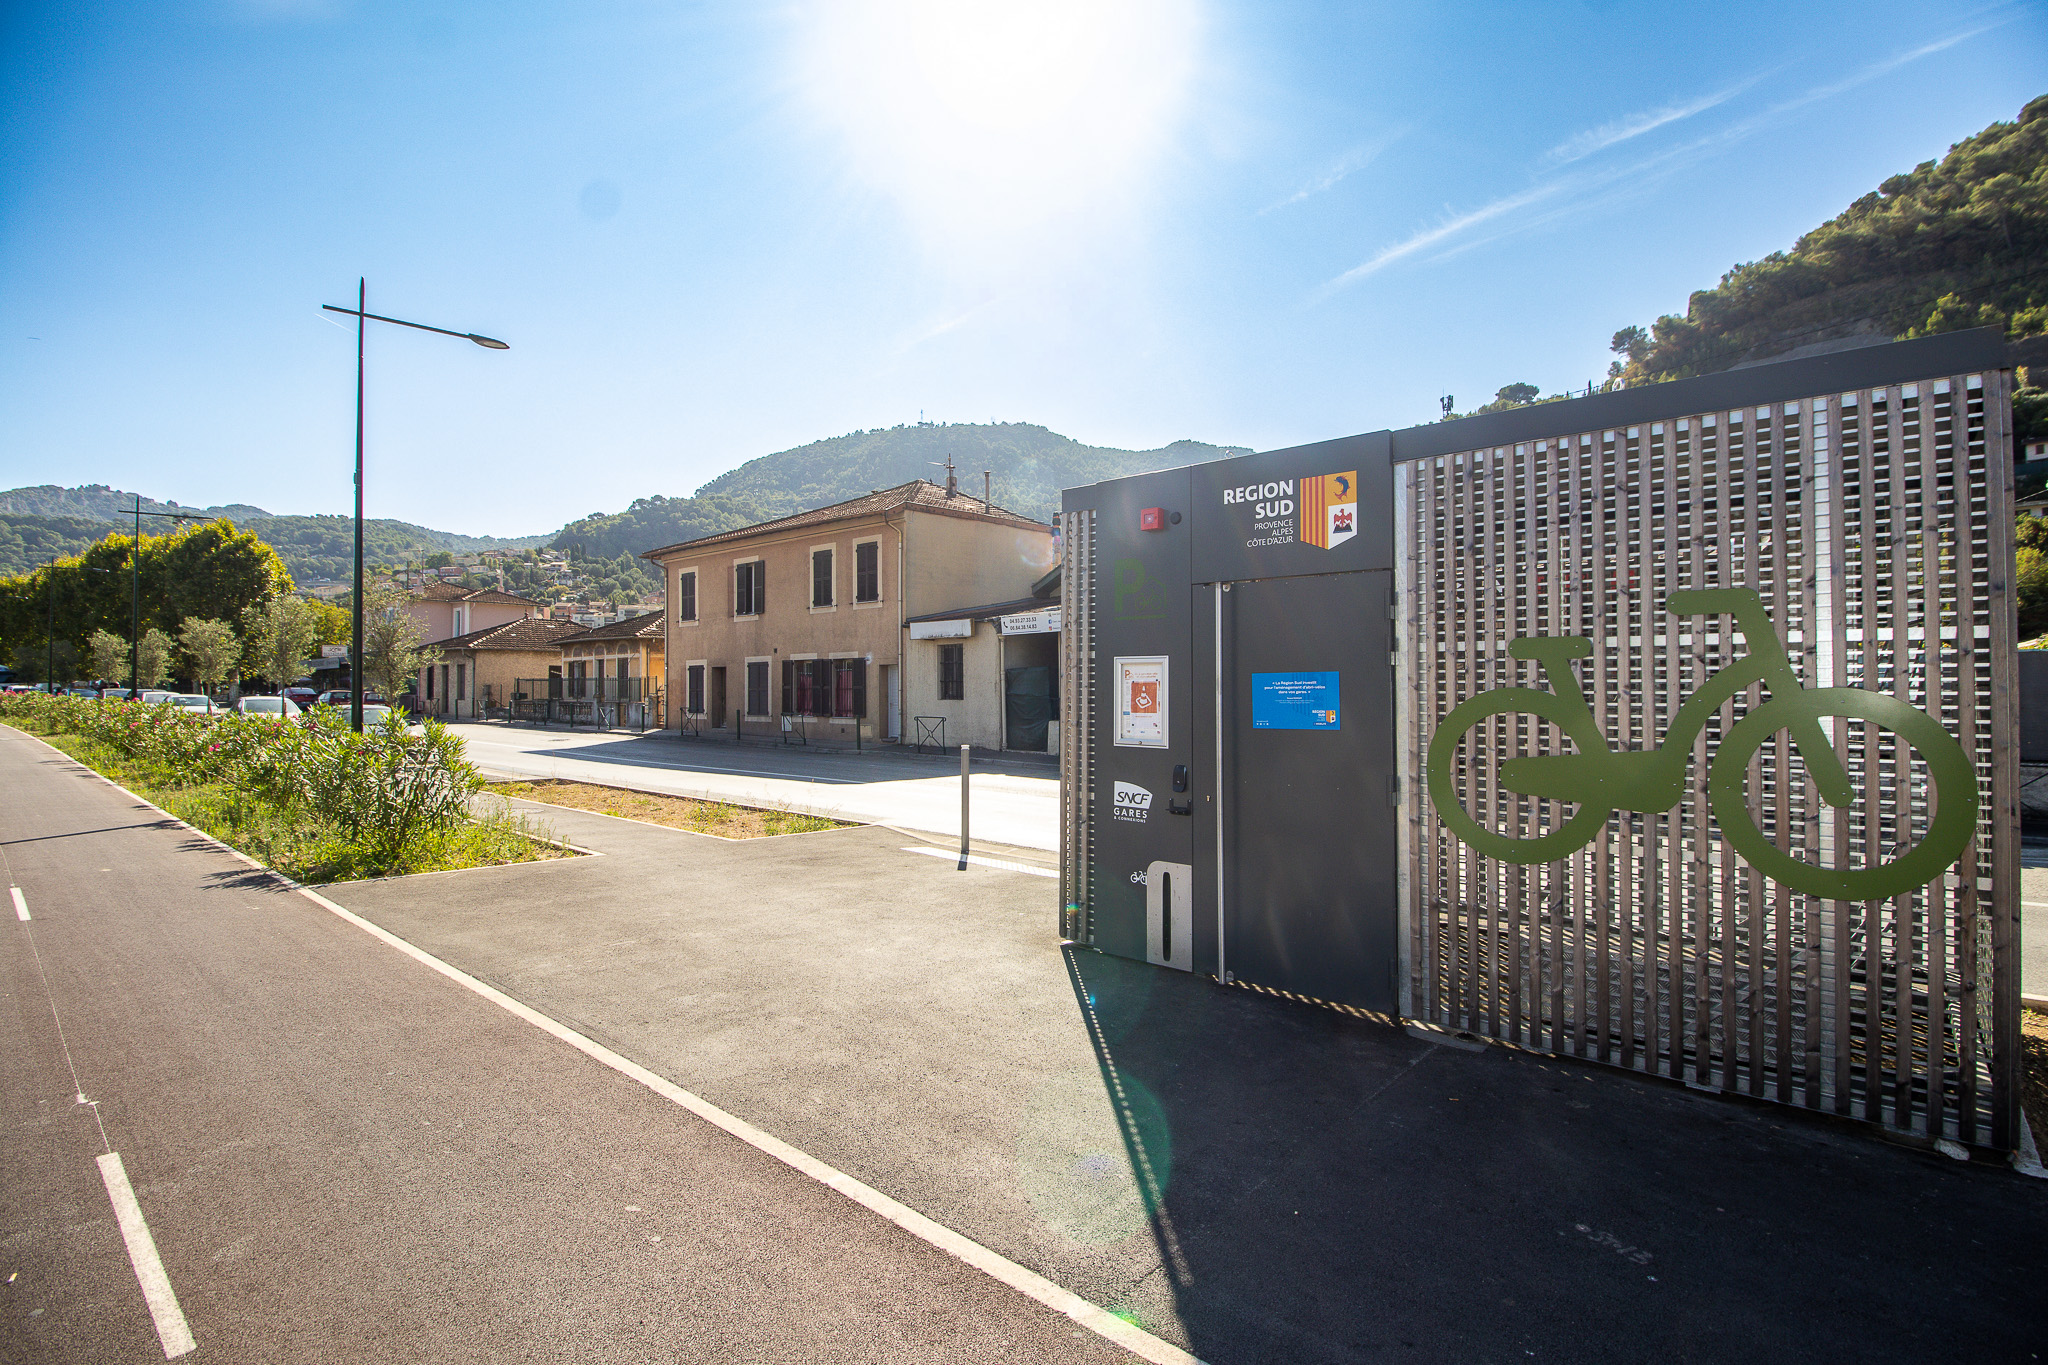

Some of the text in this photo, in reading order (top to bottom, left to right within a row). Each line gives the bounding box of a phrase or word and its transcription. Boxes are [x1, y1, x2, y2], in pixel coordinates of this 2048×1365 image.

[1223, 479, 1294, 505] REGION
[1255, 499, 1294, 519] SUD
[1254, 518, 1294, 531] PROVENCE
[1271, 526, 1294, 537] ALPES
[1246, 535, 1294, 548] CÔTE D'AZUR
[1114, 558, 1146, 613] P
[1116, 792, 1150, 804] SNCF
[1114, 808, 1147, 818] GARES
